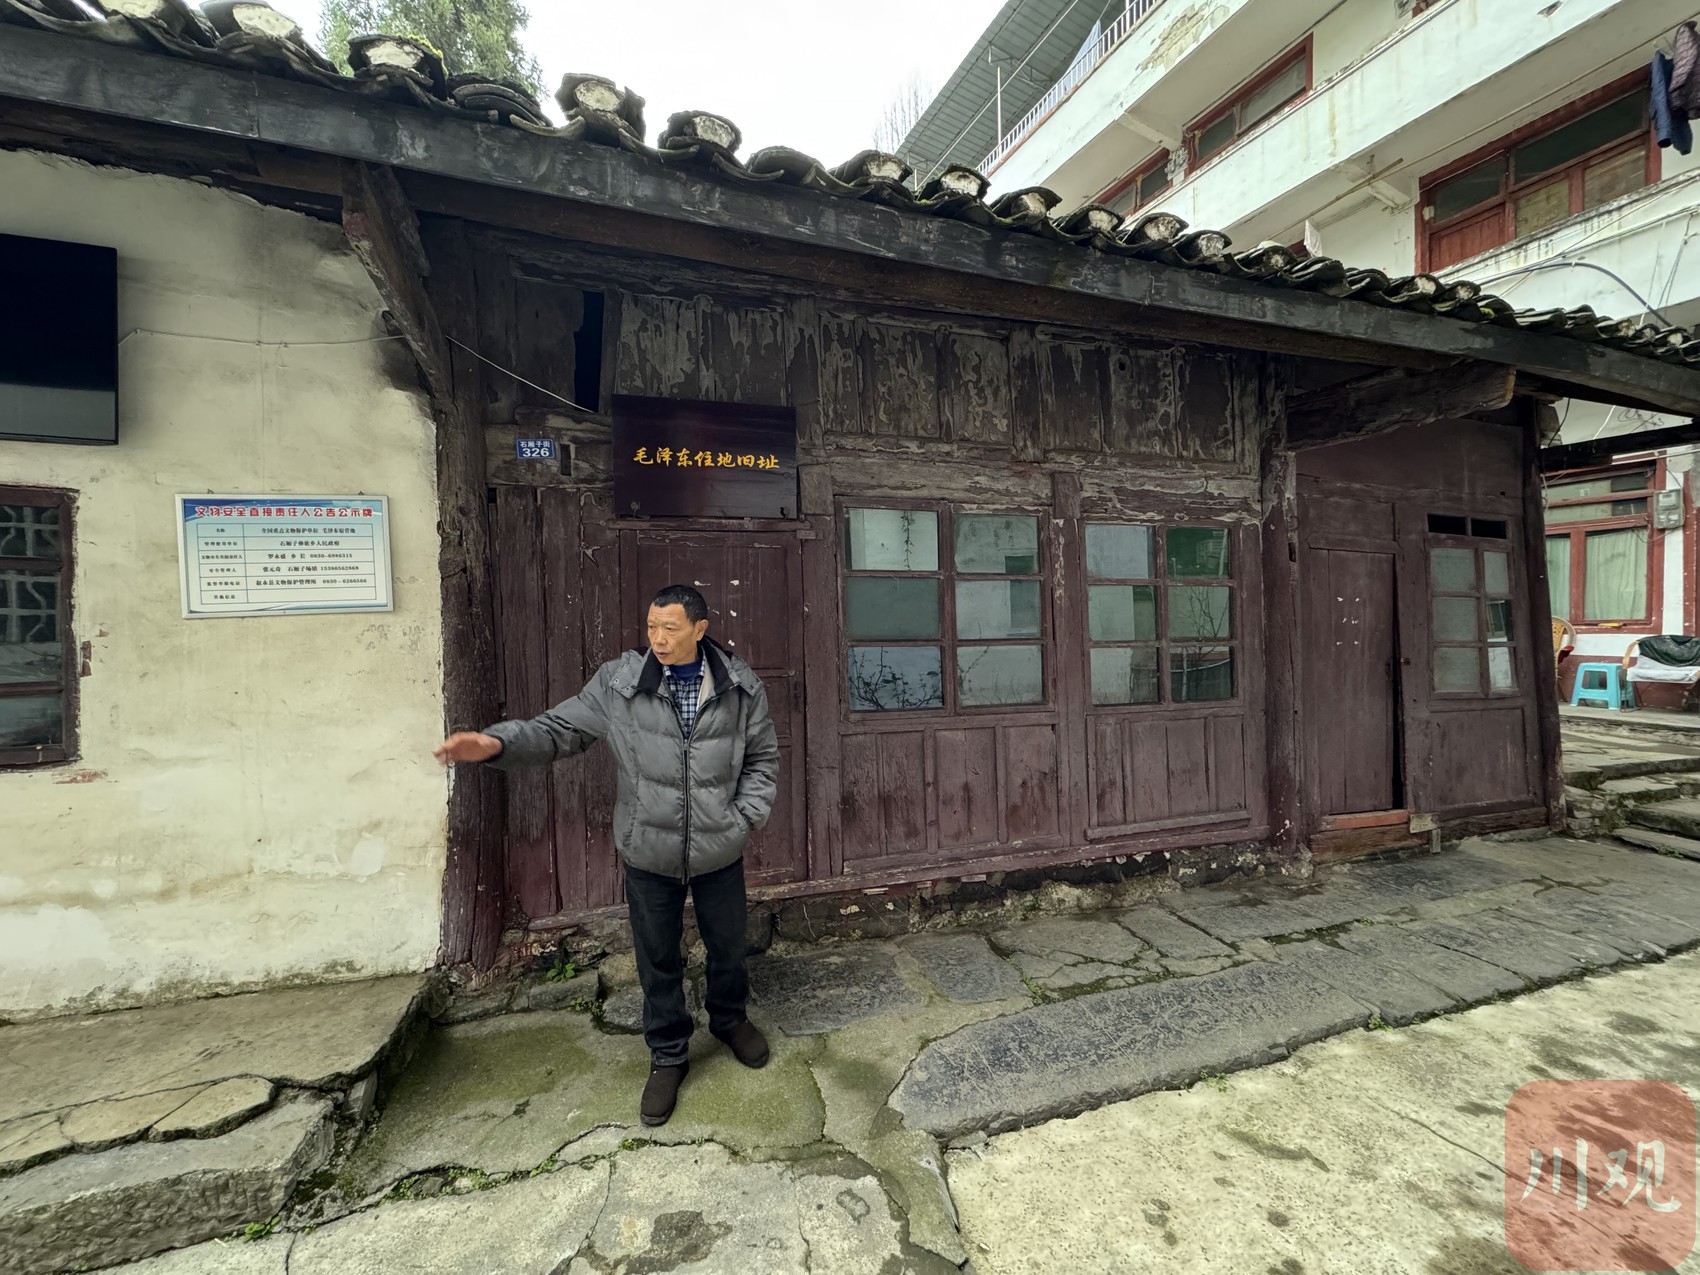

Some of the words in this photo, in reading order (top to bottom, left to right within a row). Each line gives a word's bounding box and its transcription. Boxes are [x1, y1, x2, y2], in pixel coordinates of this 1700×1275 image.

[522, 448, 550, 457] 326
[632, 446, 780, 470] 毛泽东住地旧址
[195, 506, 374, 518] 文物安全直接责任人公告公示牌
